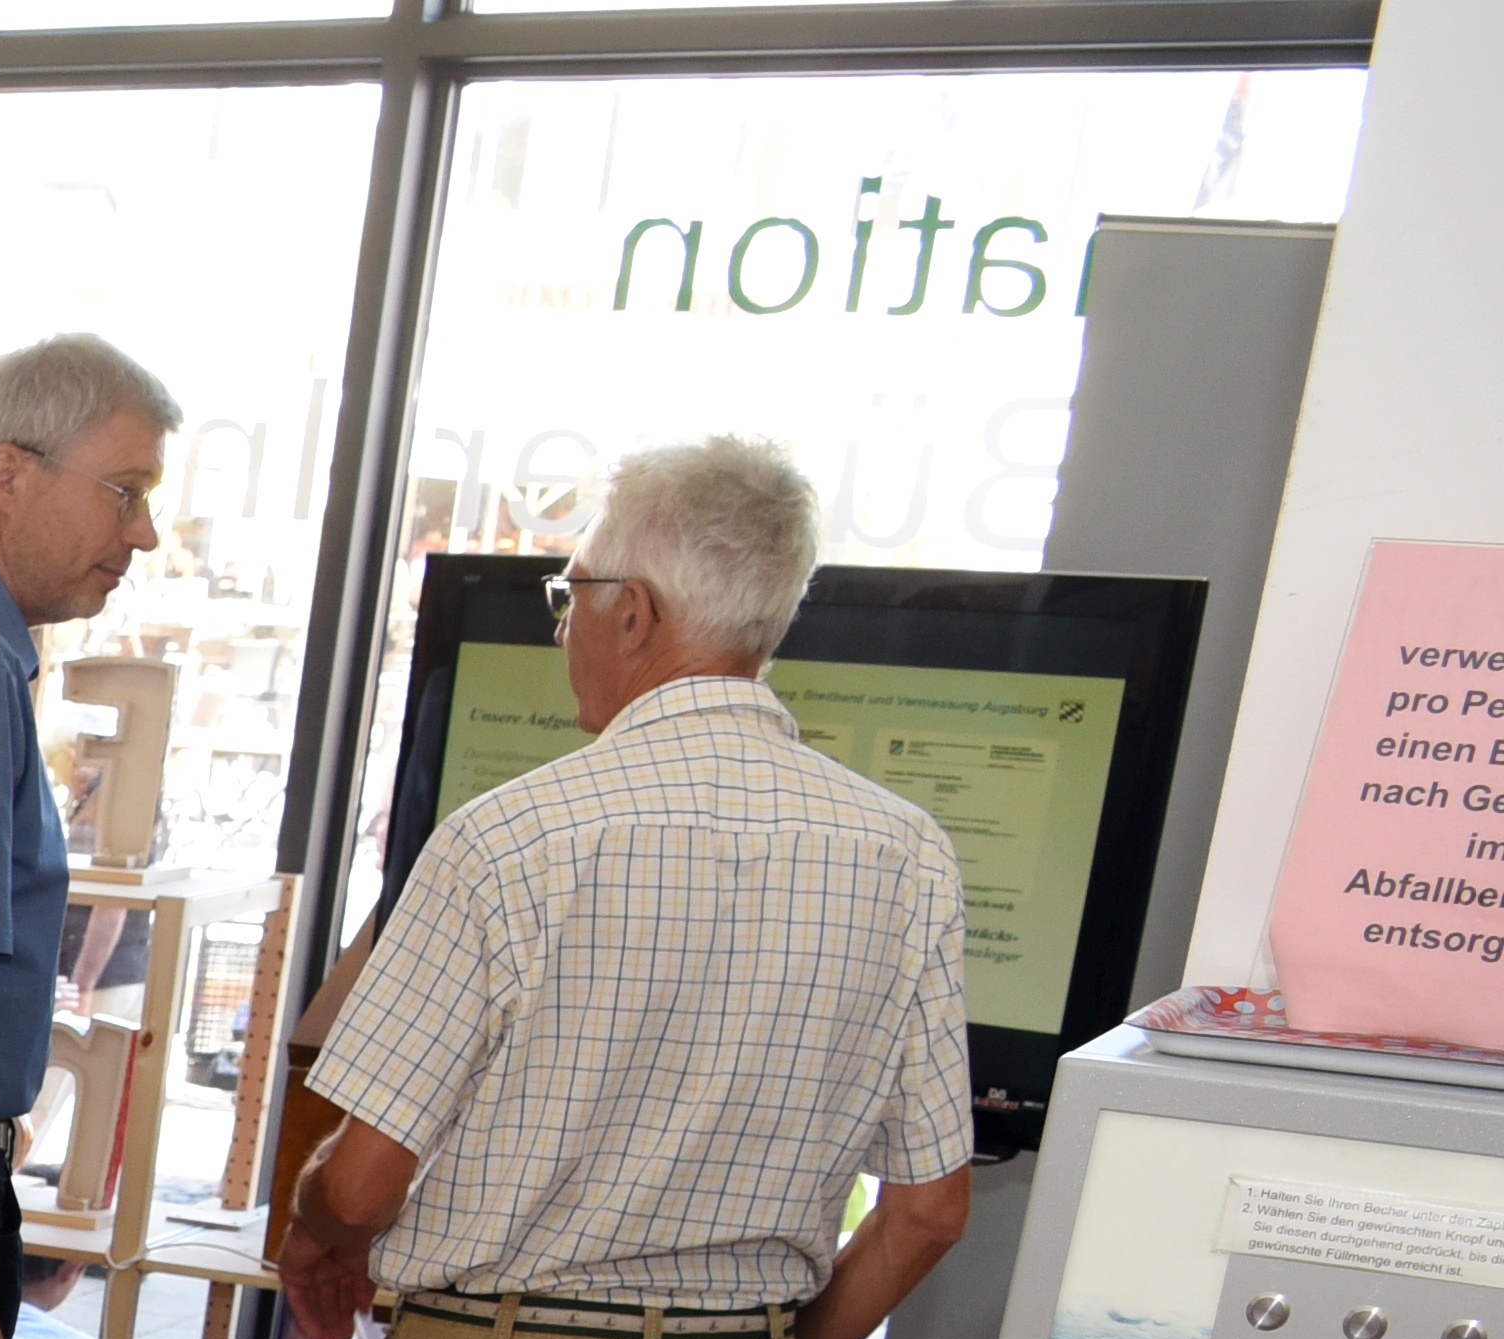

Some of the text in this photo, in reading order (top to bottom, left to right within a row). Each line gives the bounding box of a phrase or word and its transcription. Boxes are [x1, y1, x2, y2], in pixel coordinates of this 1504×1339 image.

[1399, 645, 1504, 672] verwe
[1385, 690, 1504, 719] pro Pe
[1375, 732, 1477, 764] einen
[1360, 781, 1449, 809] nach
[1363, 922, 1504, 964] entsorg
[1241, 1202, 1486, 1247] 2. Wählen Sie den gewünschten Knopf
[1247, 1186, 1474, 1227] 1. Halten Sie Ihren Becher unter den
[1247, 1239, 1465, 1279] gewünschte Füllmenge erreicht ist.
[1252, 1220, 1488, 1263] Sie diesen durchgehend gedrückt, bis
